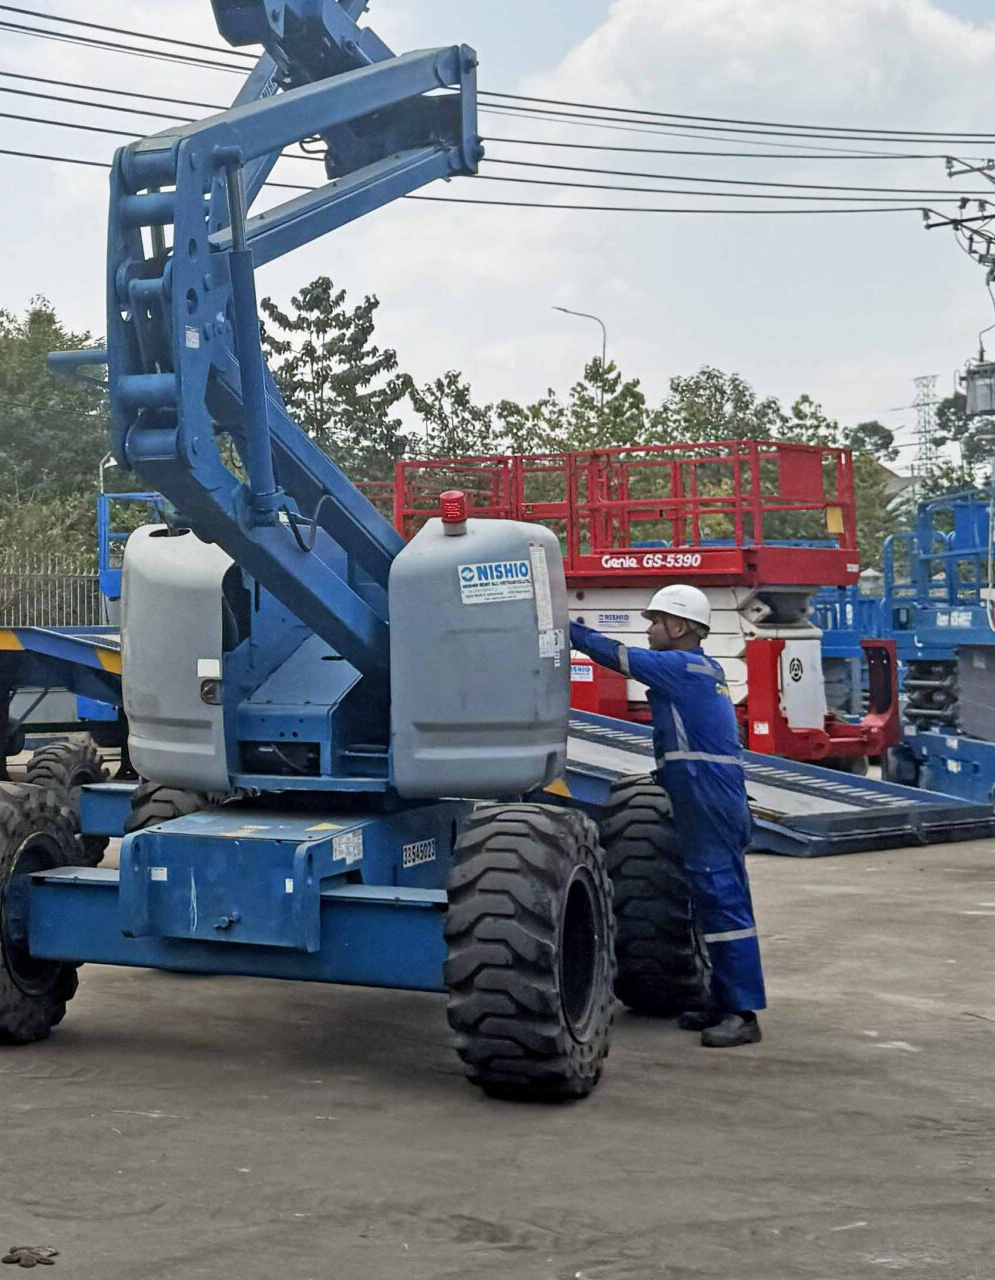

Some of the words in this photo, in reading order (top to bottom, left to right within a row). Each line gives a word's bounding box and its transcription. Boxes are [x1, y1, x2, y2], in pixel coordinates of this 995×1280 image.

[602, 555, 637, 568] Genie
[642, 554, 701, 568] GS-5390
[476, 562, 529, 580] NISHIO
